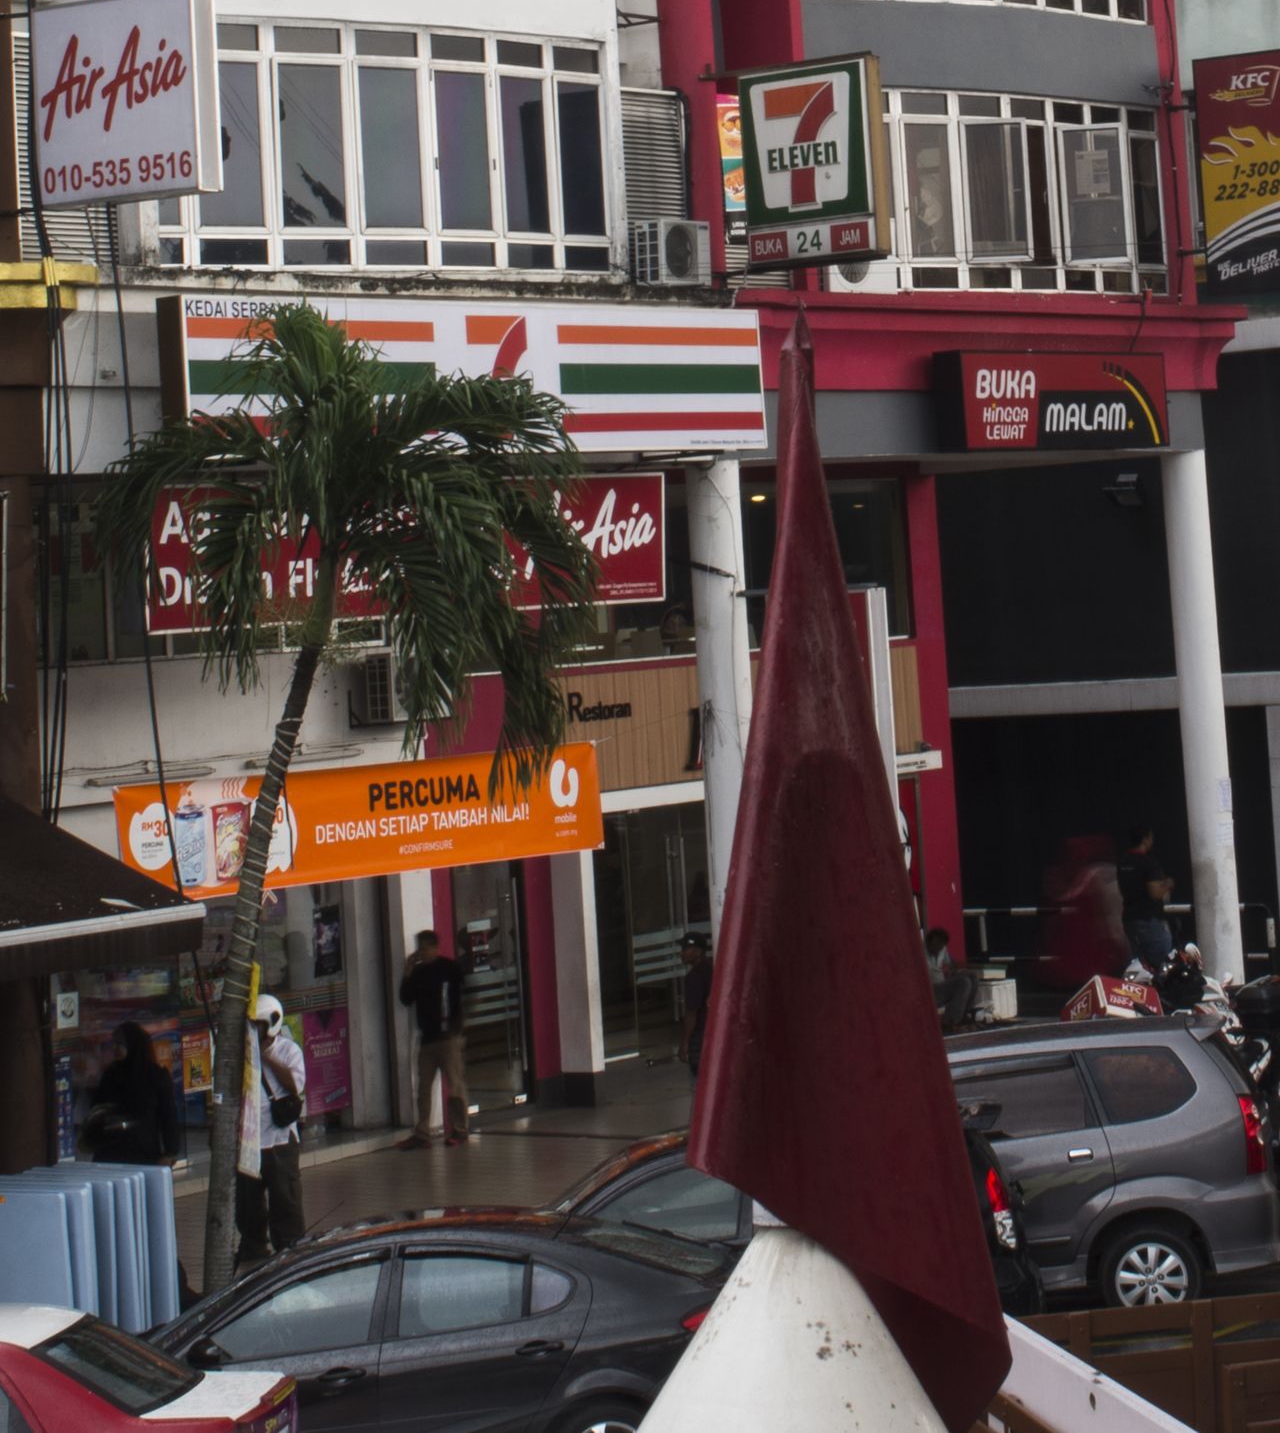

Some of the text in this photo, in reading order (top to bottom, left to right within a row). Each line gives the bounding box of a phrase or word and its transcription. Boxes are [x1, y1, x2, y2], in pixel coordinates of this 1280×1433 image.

[1229, 71, 1271, 91] KFC
[44, 150, 194, 195] 010-535 9516
[1233, 160, 1280, 180] 1-300
[754, 228, 861, 256] BUKA 24 JAM
[1220, 248, 1278, 281] DELIVER
[185, 299, 227, 317] KEDAI
[975, 368, 1036, 399] BUKA
[1045, 402, 1127, 433] MALAM
[986, 424, 1027, 440] LEWAT
[567, 692, 632, 723] Restoran
[368, 773, 481, 813] PERCUMA
[315, 819, 377, 845] DENGAN
[379, 812, 429, 838] SETIAP
[431, 806, 488, 832] TAMBAH
[490, 802, 530, 825] NILAI!
[554, 811, 577, 825] mobile
[398, 838, 454, 855] #CONFIRMSURE
[1121, 983, 1142, 995] KFC
